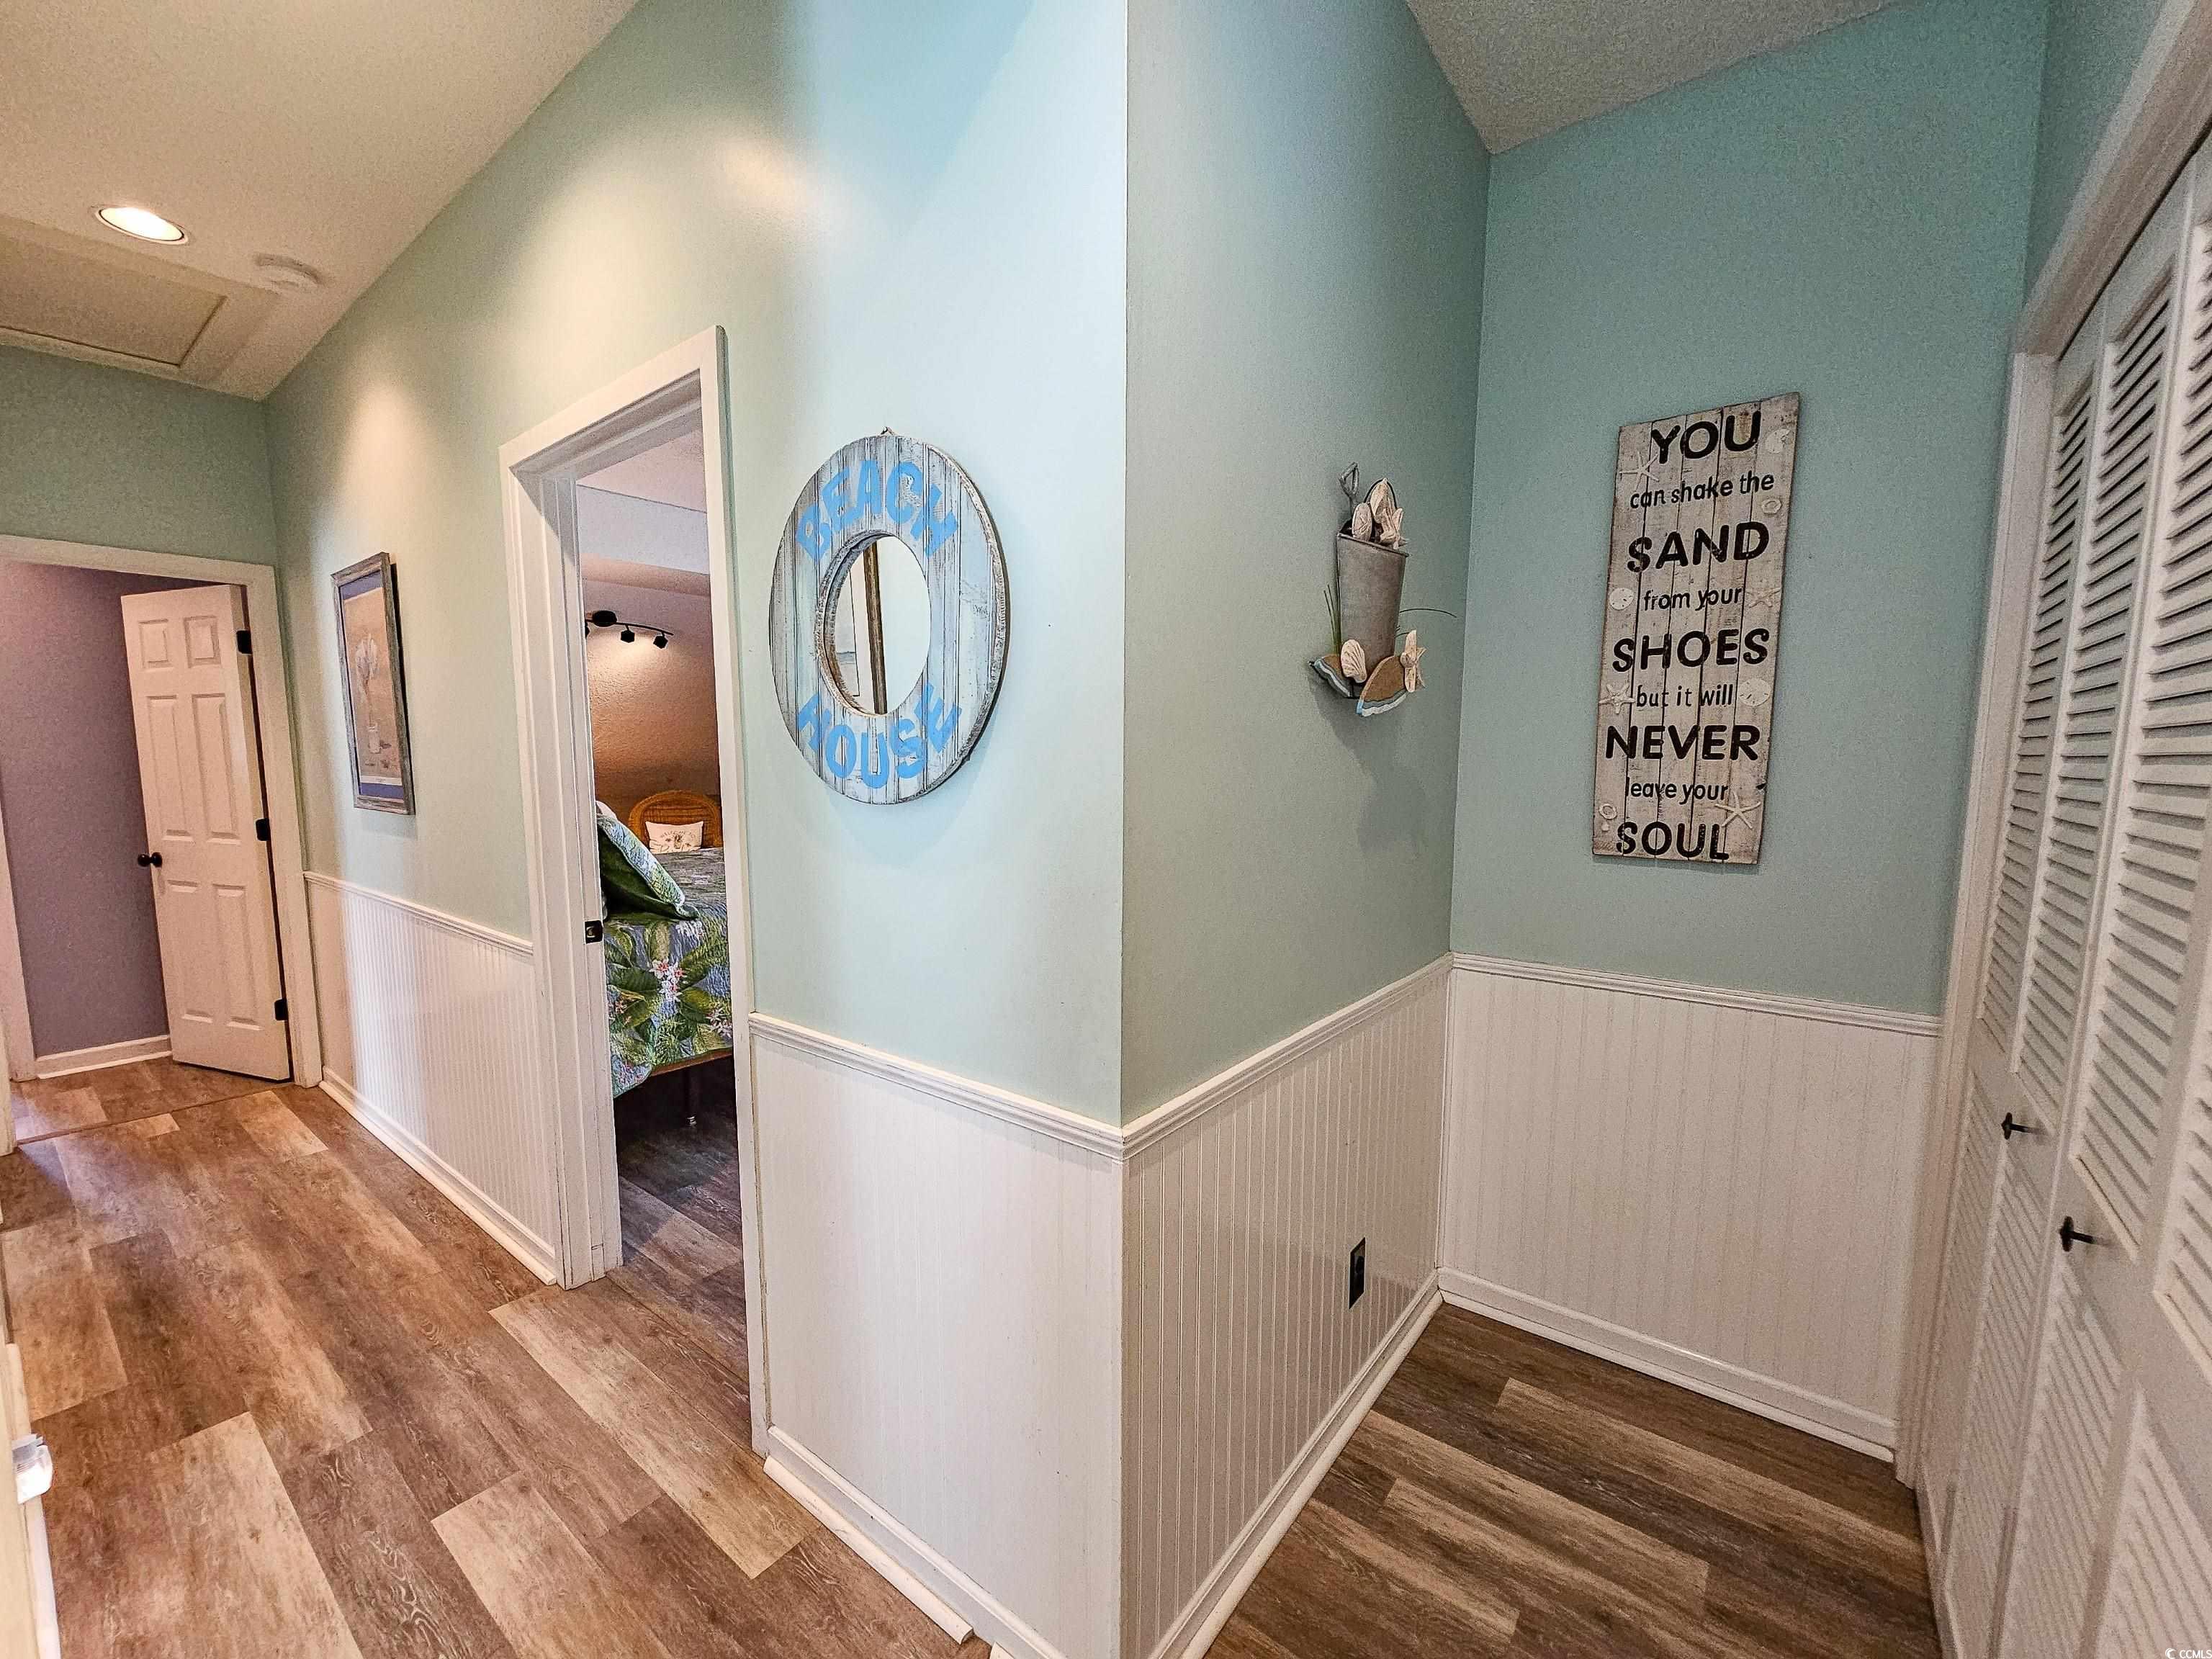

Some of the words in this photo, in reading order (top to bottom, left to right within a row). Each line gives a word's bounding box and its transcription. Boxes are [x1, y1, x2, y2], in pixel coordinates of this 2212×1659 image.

[1651, 410, 1761, 464] YOU
[1630, 490, 1666, 508] can
[1671, 477, 1733, 504] shake
[1739, 471, 1774, 495] the
[795, 459, 958, 562] BEACH
[1627, 521, 1770, 572] SAND
[1644, 590, 1691, 611] from
[1694, 586, 1743, 611] your
[1612, 628, 1770, 673] SHOES
[1636, 685, 1668, 707] but
[1676, 685, 1692, 706] it
[1699, 684, 1733, 706] will
[798, 683, 962, 789] HOUSE
[1605, 724, 1761, 761] NEVER
[1625, 776, 1677, 799] leave
[1678, 783, 1729, 805] your
[1616, 821, 1730, 860] SOUL
